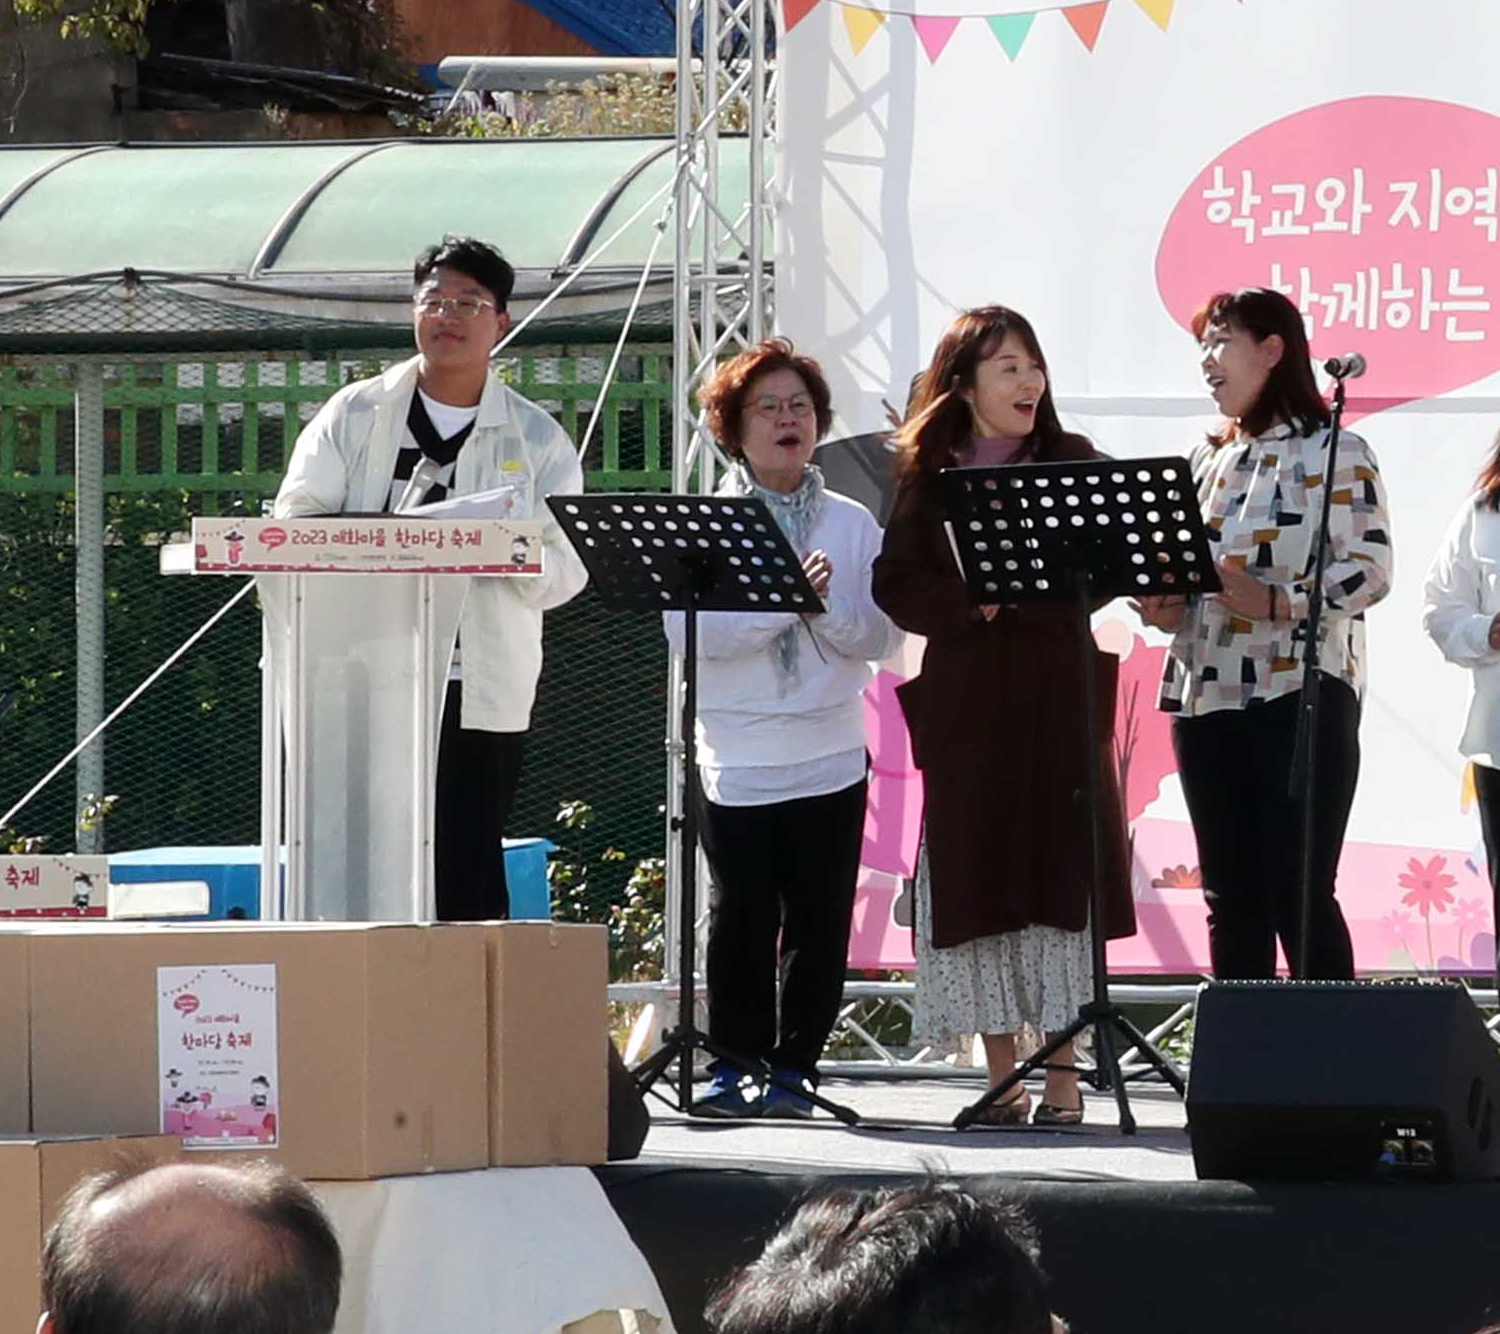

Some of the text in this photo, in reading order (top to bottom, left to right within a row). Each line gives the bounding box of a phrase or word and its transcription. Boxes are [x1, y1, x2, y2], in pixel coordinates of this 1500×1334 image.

[1202, 167, 1372, 243] 학교와
[292, 531, 327, 546] 2023
[331, 527, 386, 547] 매화마을
[395, 527, 443, 549] 한마당
[450, 528, 481, 549] 축제
[5, 866, 40, 889] 축제
[181, 1032, 222, 1050] 한마당
